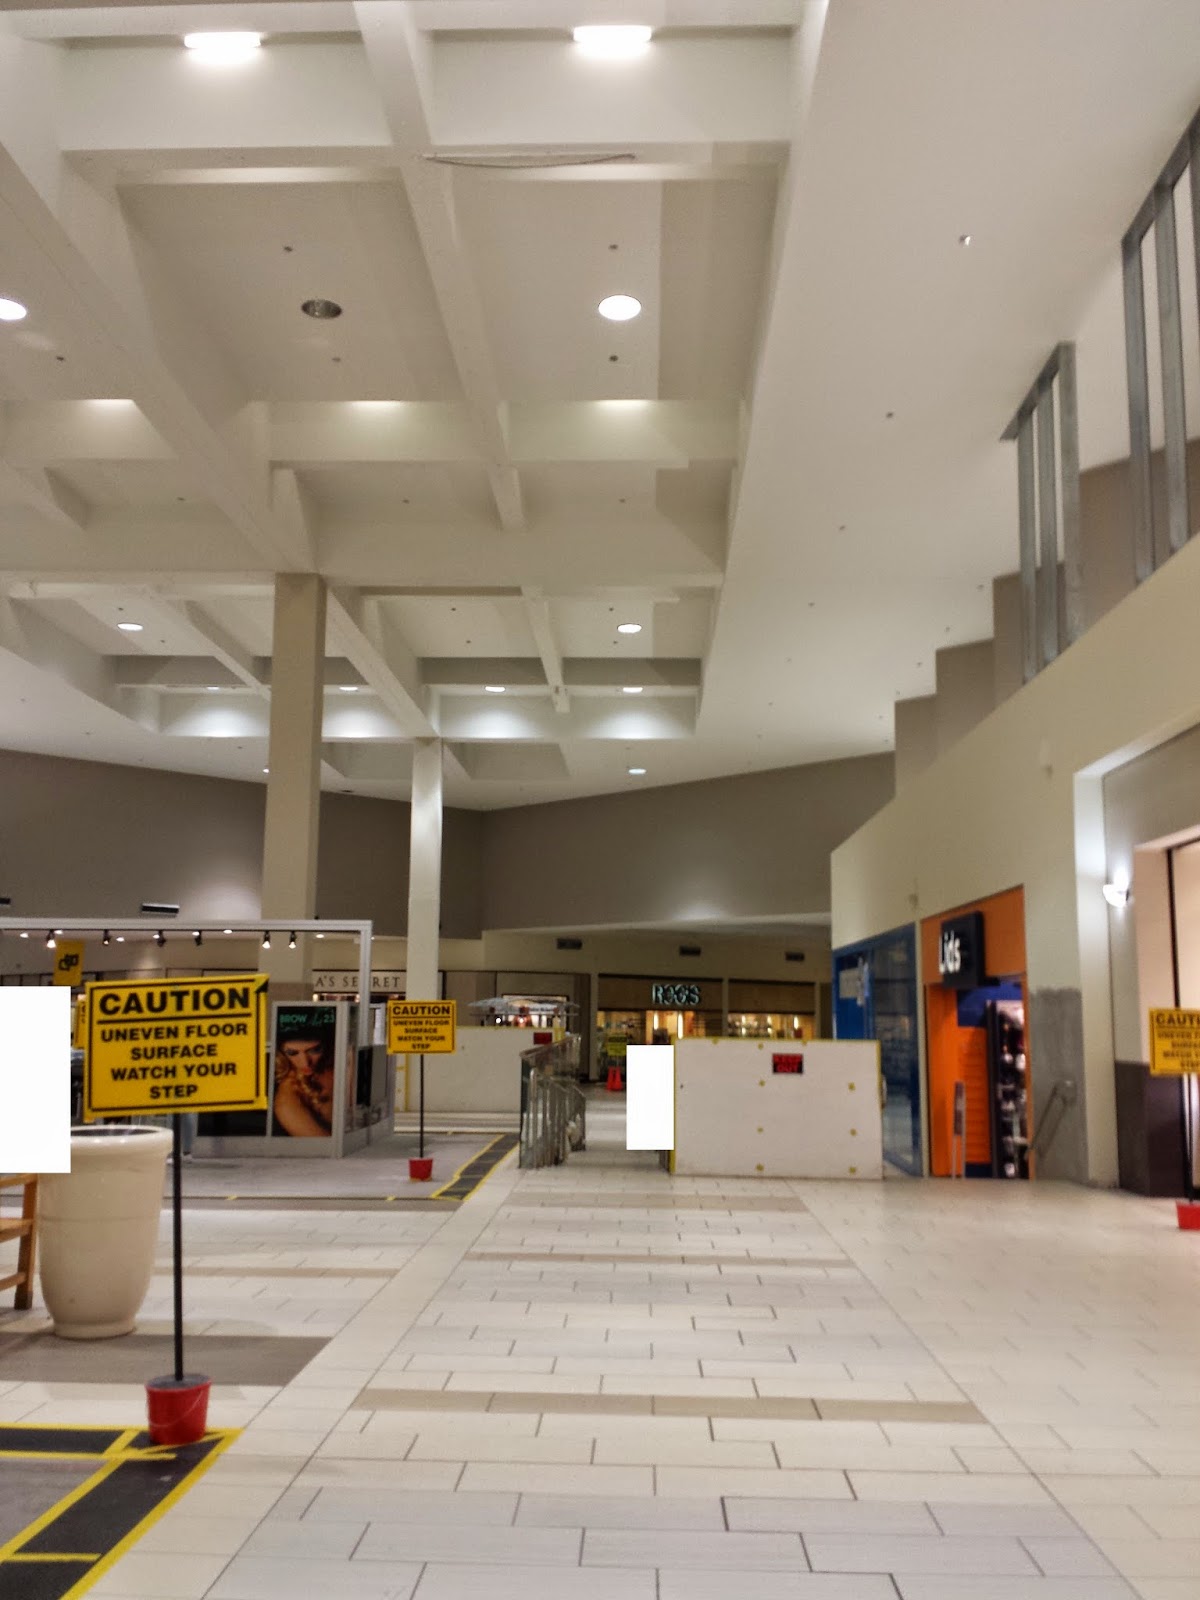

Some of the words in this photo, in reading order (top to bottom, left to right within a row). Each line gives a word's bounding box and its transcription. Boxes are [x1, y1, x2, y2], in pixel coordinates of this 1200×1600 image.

[343, 976, 400, 988] SERET
[99, 987, 250, 1015] CAUTION
[392, 1006, 450, 1015] CAUTION
[101, 1026, 179, 1042] UNEVEN
[185, 1023, 248, 1038] FLOOR
[131, 1043, 218, 1060] SURFACE
[111, 1065, 176, 1081] WATCH
[184, 1062, 237, 1077] YOUR
[150, 1084, 198, 1099] STEP
